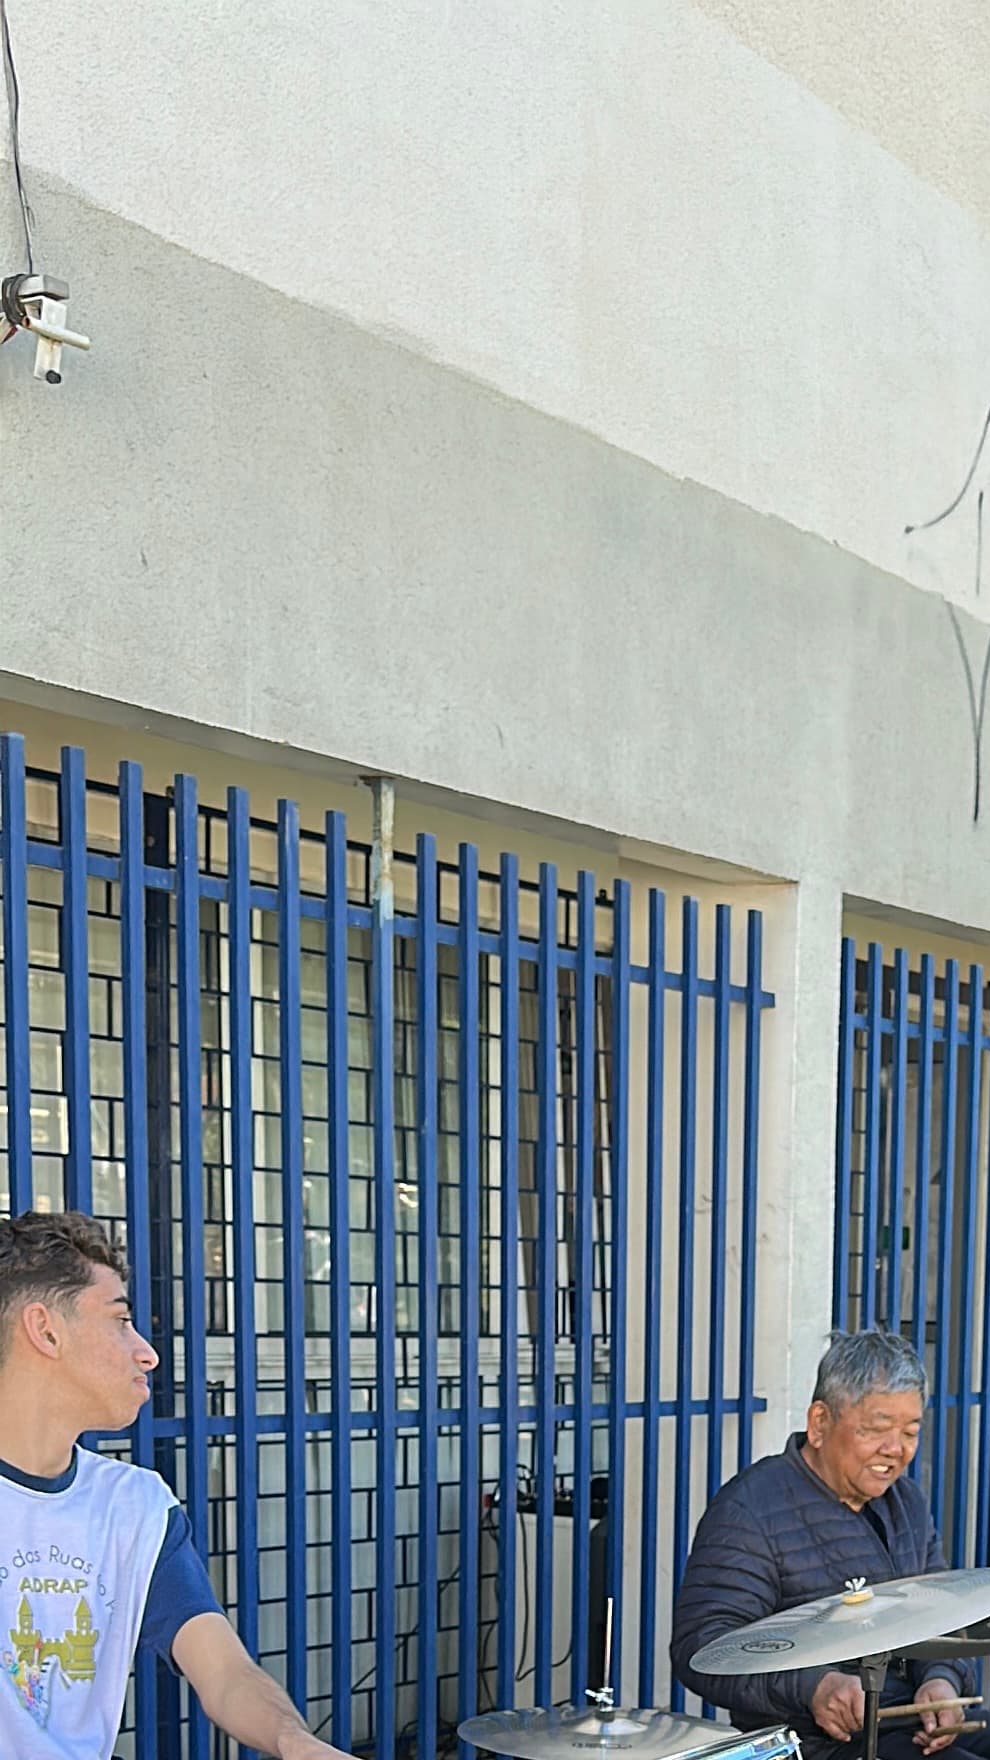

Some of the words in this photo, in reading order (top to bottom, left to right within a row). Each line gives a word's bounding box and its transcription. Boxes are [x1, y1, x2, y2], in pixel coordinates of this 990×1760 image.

[12, 1549, 41, 1569] das
[49, 1544, 93, 1575] Ruas
[20, 1576, 88, 1593] ADRAP
